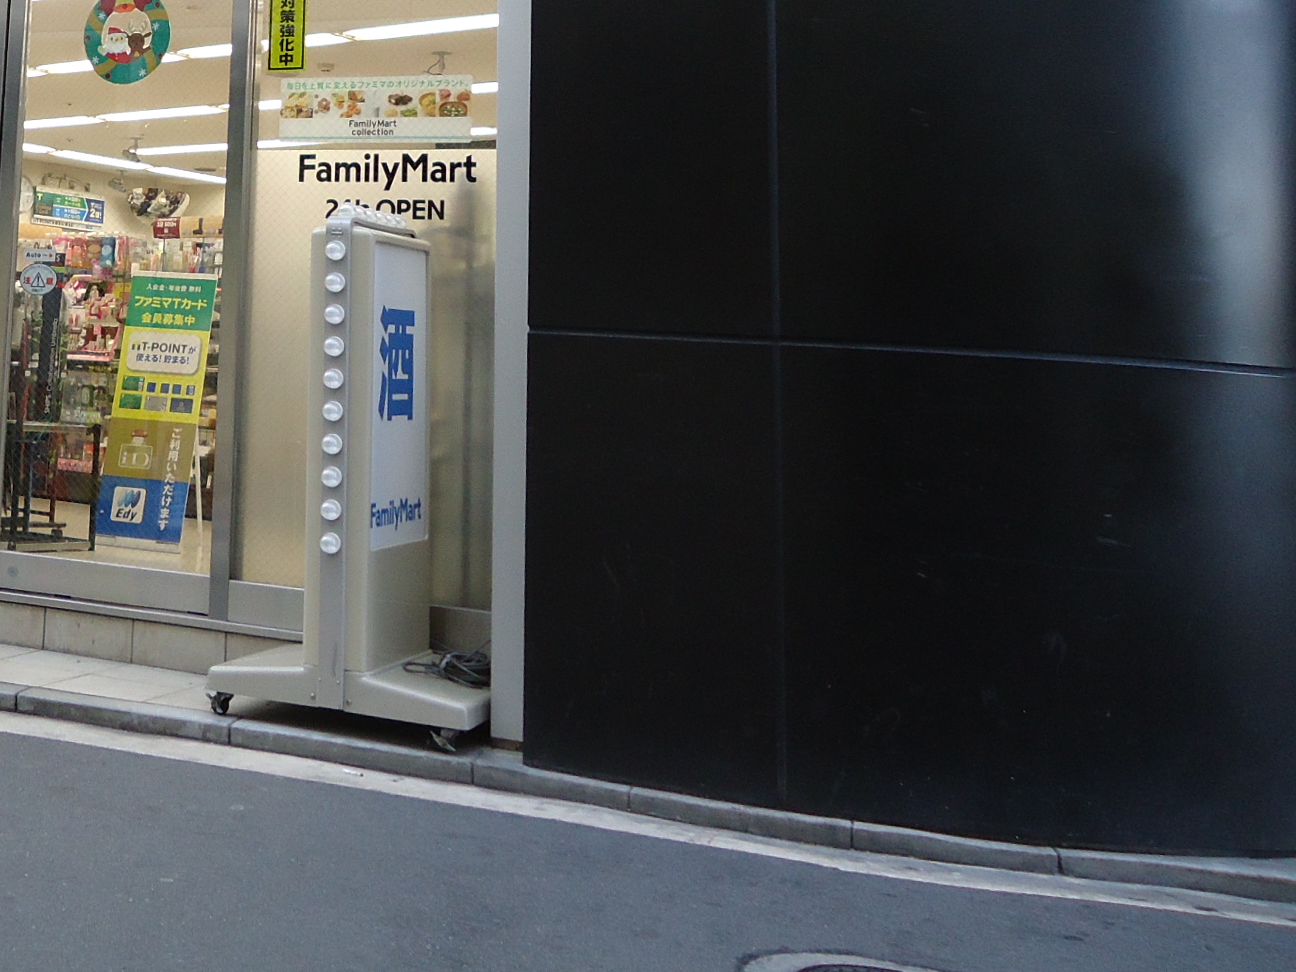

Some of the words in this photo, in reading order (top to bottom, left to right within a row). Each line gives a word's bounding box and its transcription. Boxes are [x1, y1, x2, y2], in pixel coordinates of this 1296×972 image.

[348, 119, 397, 129] FamilyMart
[351, 128, 394, 137] collection
[298, 153, 477, 192] FamilyMart
[26, 251, 42, 259] Auto
[135, 296, 208, 311] ファミマTカード
[141, 312, 196, 326] 会員募集中
[378, 304, 416, 422] 酒
[120, 451, 150, 466] iD
[158, 428, 183, 531] ご利用いただけます
[115, 508, 138, 522] Edy
[370, 497, 422, 531] FamilyMart
